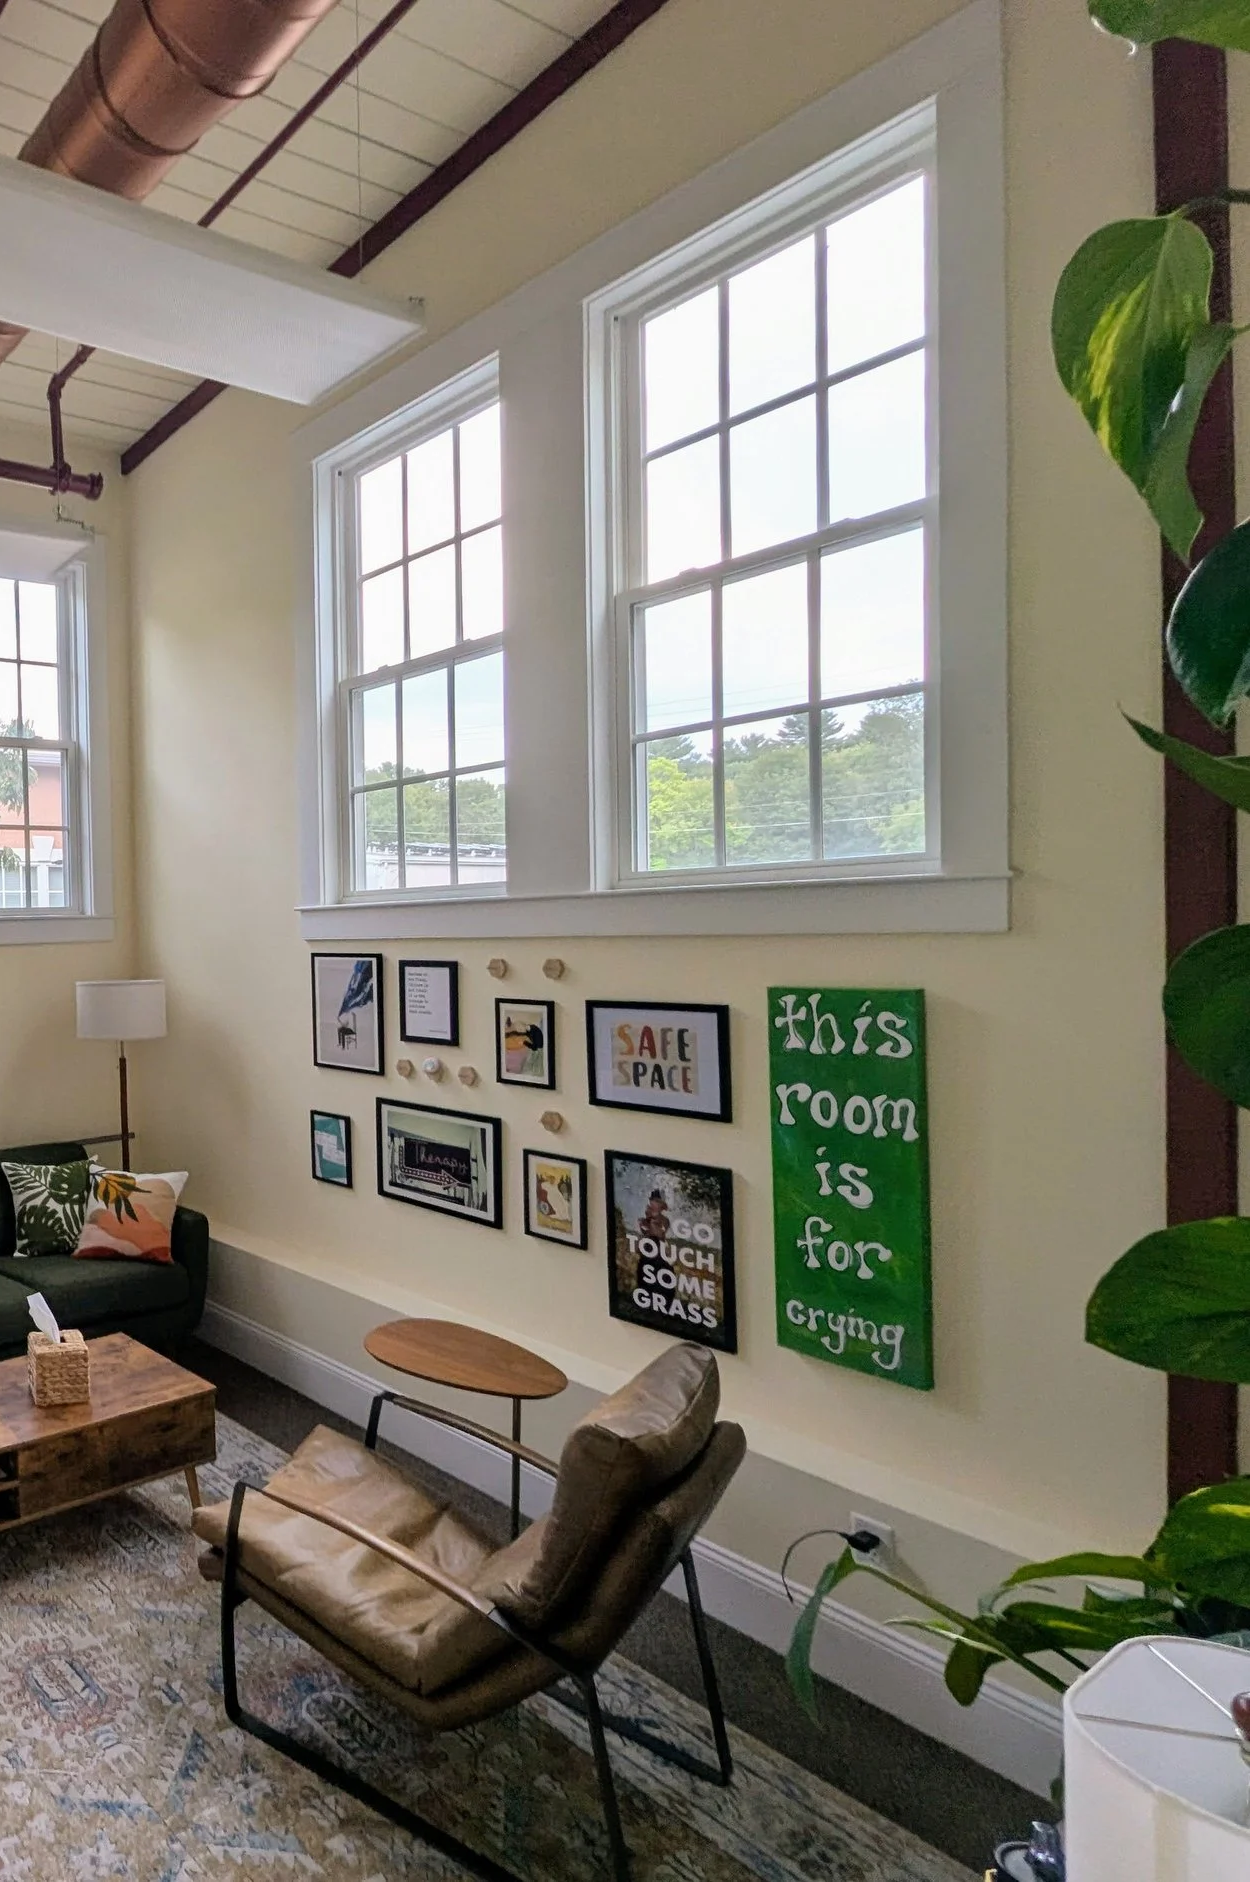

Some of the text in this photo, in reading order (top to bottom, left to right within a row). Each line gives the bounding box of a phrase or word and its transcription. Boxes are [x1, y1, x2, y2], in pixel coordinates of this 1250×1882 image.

[617, 1024, 692, 1062] SAFE
[775, 993, 913, 1058] this
[617, 1061, 693, 1094] SPACE
[776, 1083, 919, 1141] room
[413, 1140, 469, 1175] Therapy
[814, 1147, 873, 1208] is
[671, 1219, 714, 1245] GO
[797, 1216, 892, 1279] for
[626, 1233, 715, 1273] TOUCH
[642, 1264, 716, 1301] SOME
[632, 1288, 718, 1328] GRASS
[786, 1300, 905, 1370] crying
